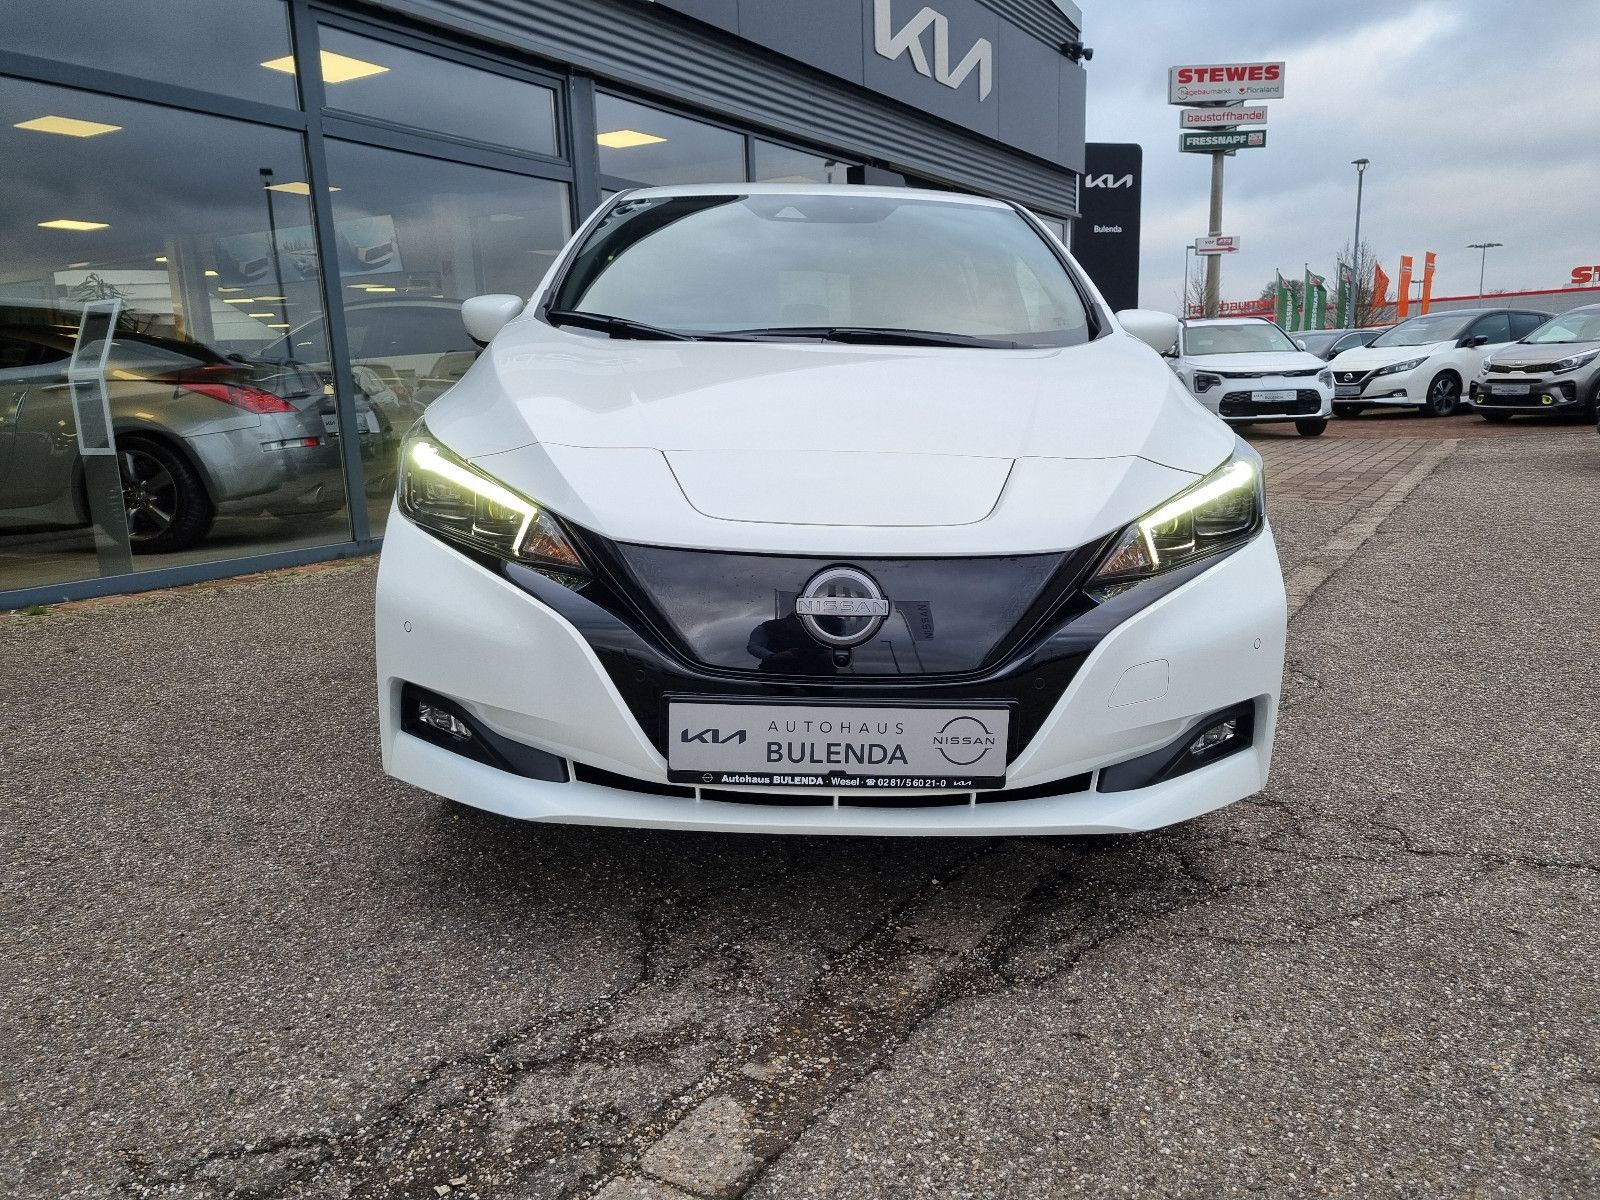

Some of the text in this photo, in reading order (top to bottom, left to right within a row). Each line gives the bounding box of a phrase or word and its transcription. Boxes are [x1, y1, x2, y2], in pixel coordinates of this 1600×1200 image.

[1178, 65, 1280, 84] STEWES
[1187, 111, 1264, 122] baustoffhandel
[1186, 135, 1247, 146] FRESSNAPF
[1085, 173, 1133, 188] KIA
[1094, 225, 1122, 233] Bulenda
[799, 600, 888, 614] NISSAN
[767, 720, 905, 735] AUTOHAUS
[680, 728, 747, 745] KIA
[933, 736, 996, 745] NISSAN
[766, 741, 909, 765] BULENDA
[722, 774, 770, 784] Autohaus
[773, 775, 824, 785] BULENDA
[830, 777, 860, 786] Wesel
